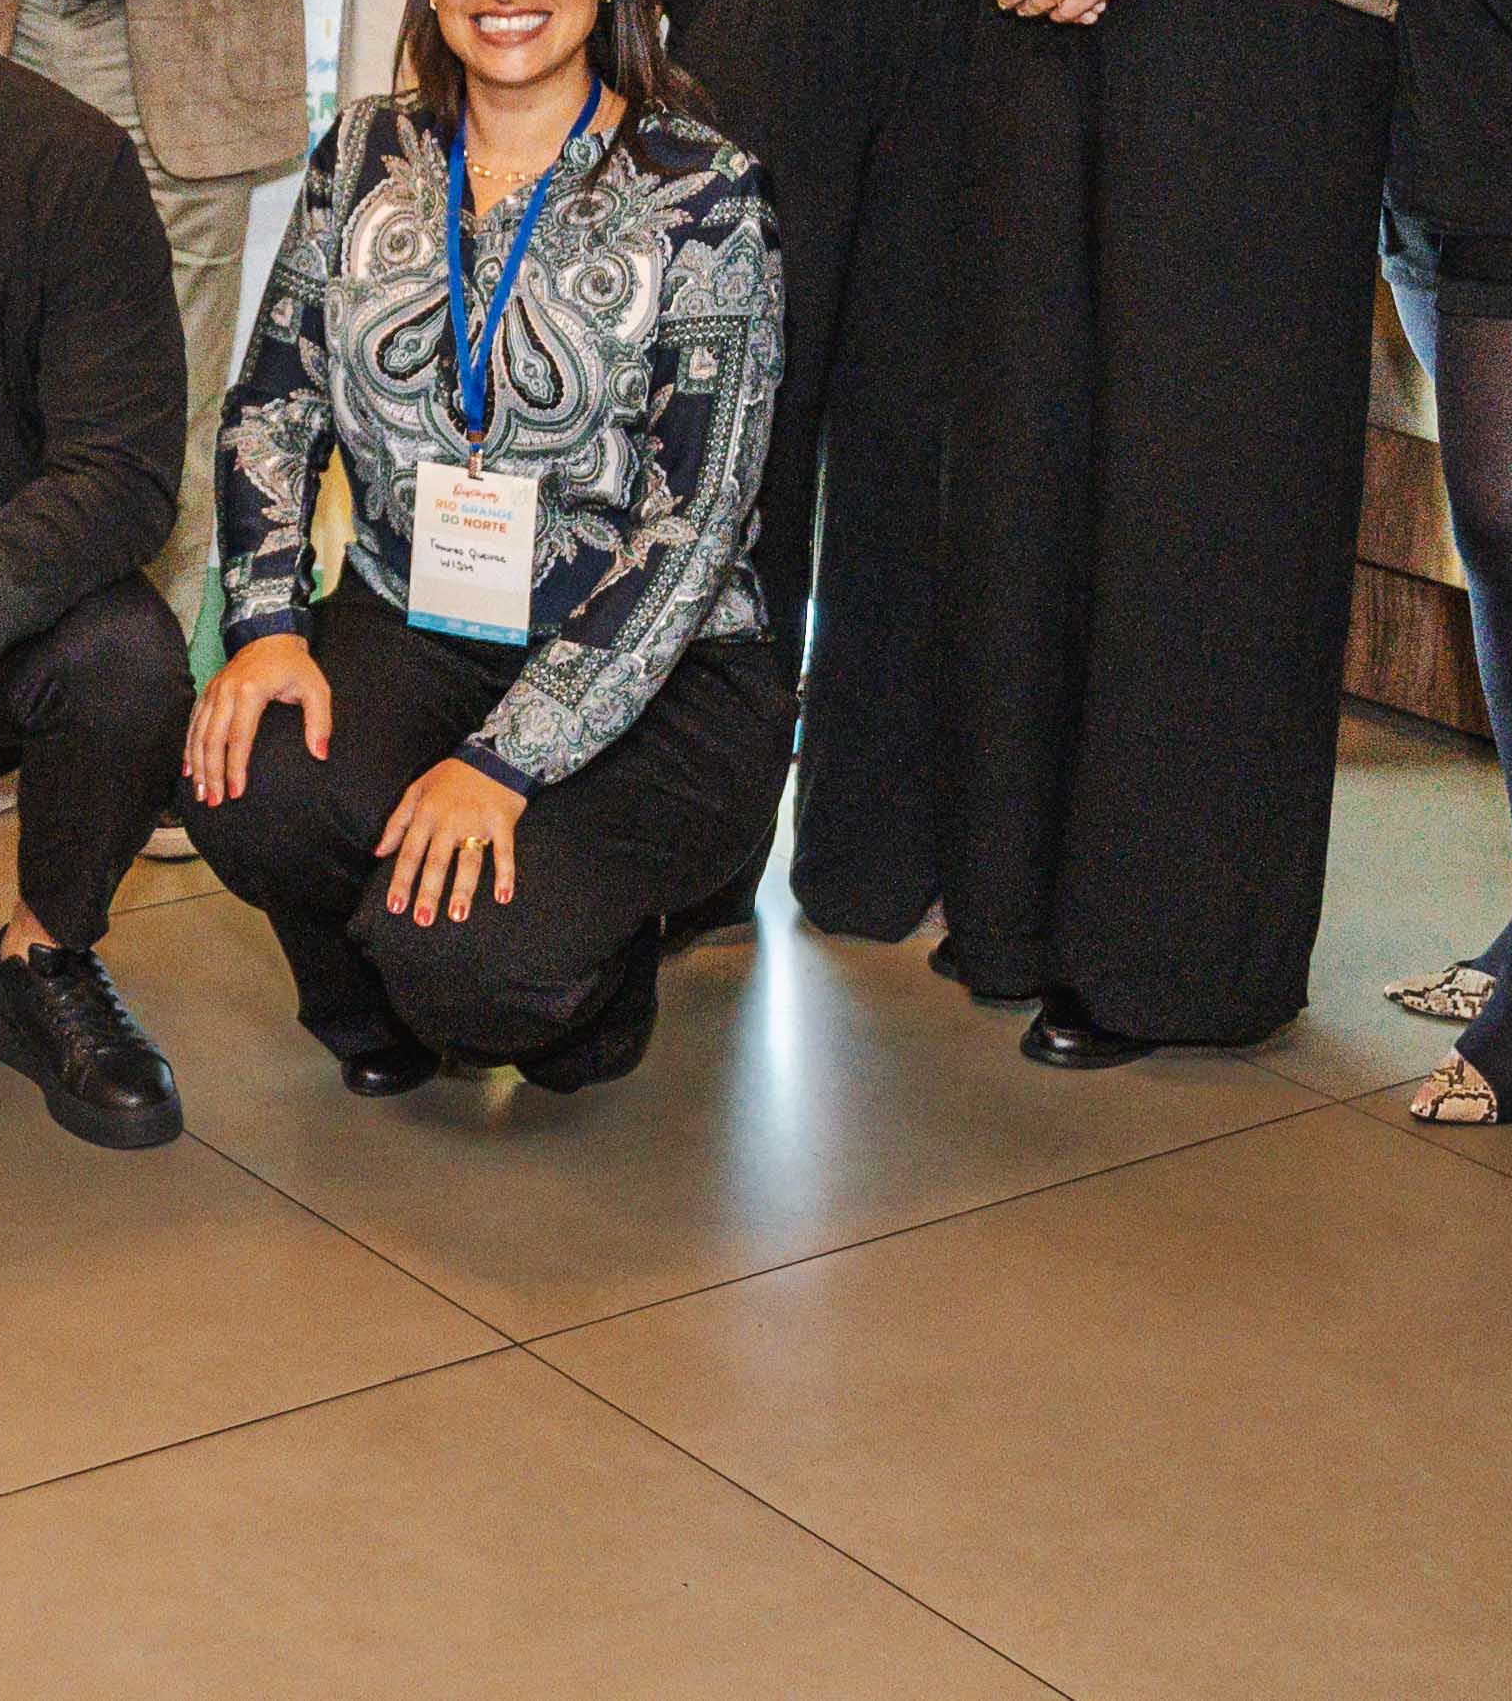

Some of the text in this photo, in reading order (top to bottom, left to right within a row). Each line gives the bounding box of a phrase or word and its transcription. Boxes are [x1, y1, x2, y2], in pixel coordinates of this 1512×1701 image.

[434, 498, 514, 520] RIO GRANDE
[441, 513, 508, 534] DO NORTE
